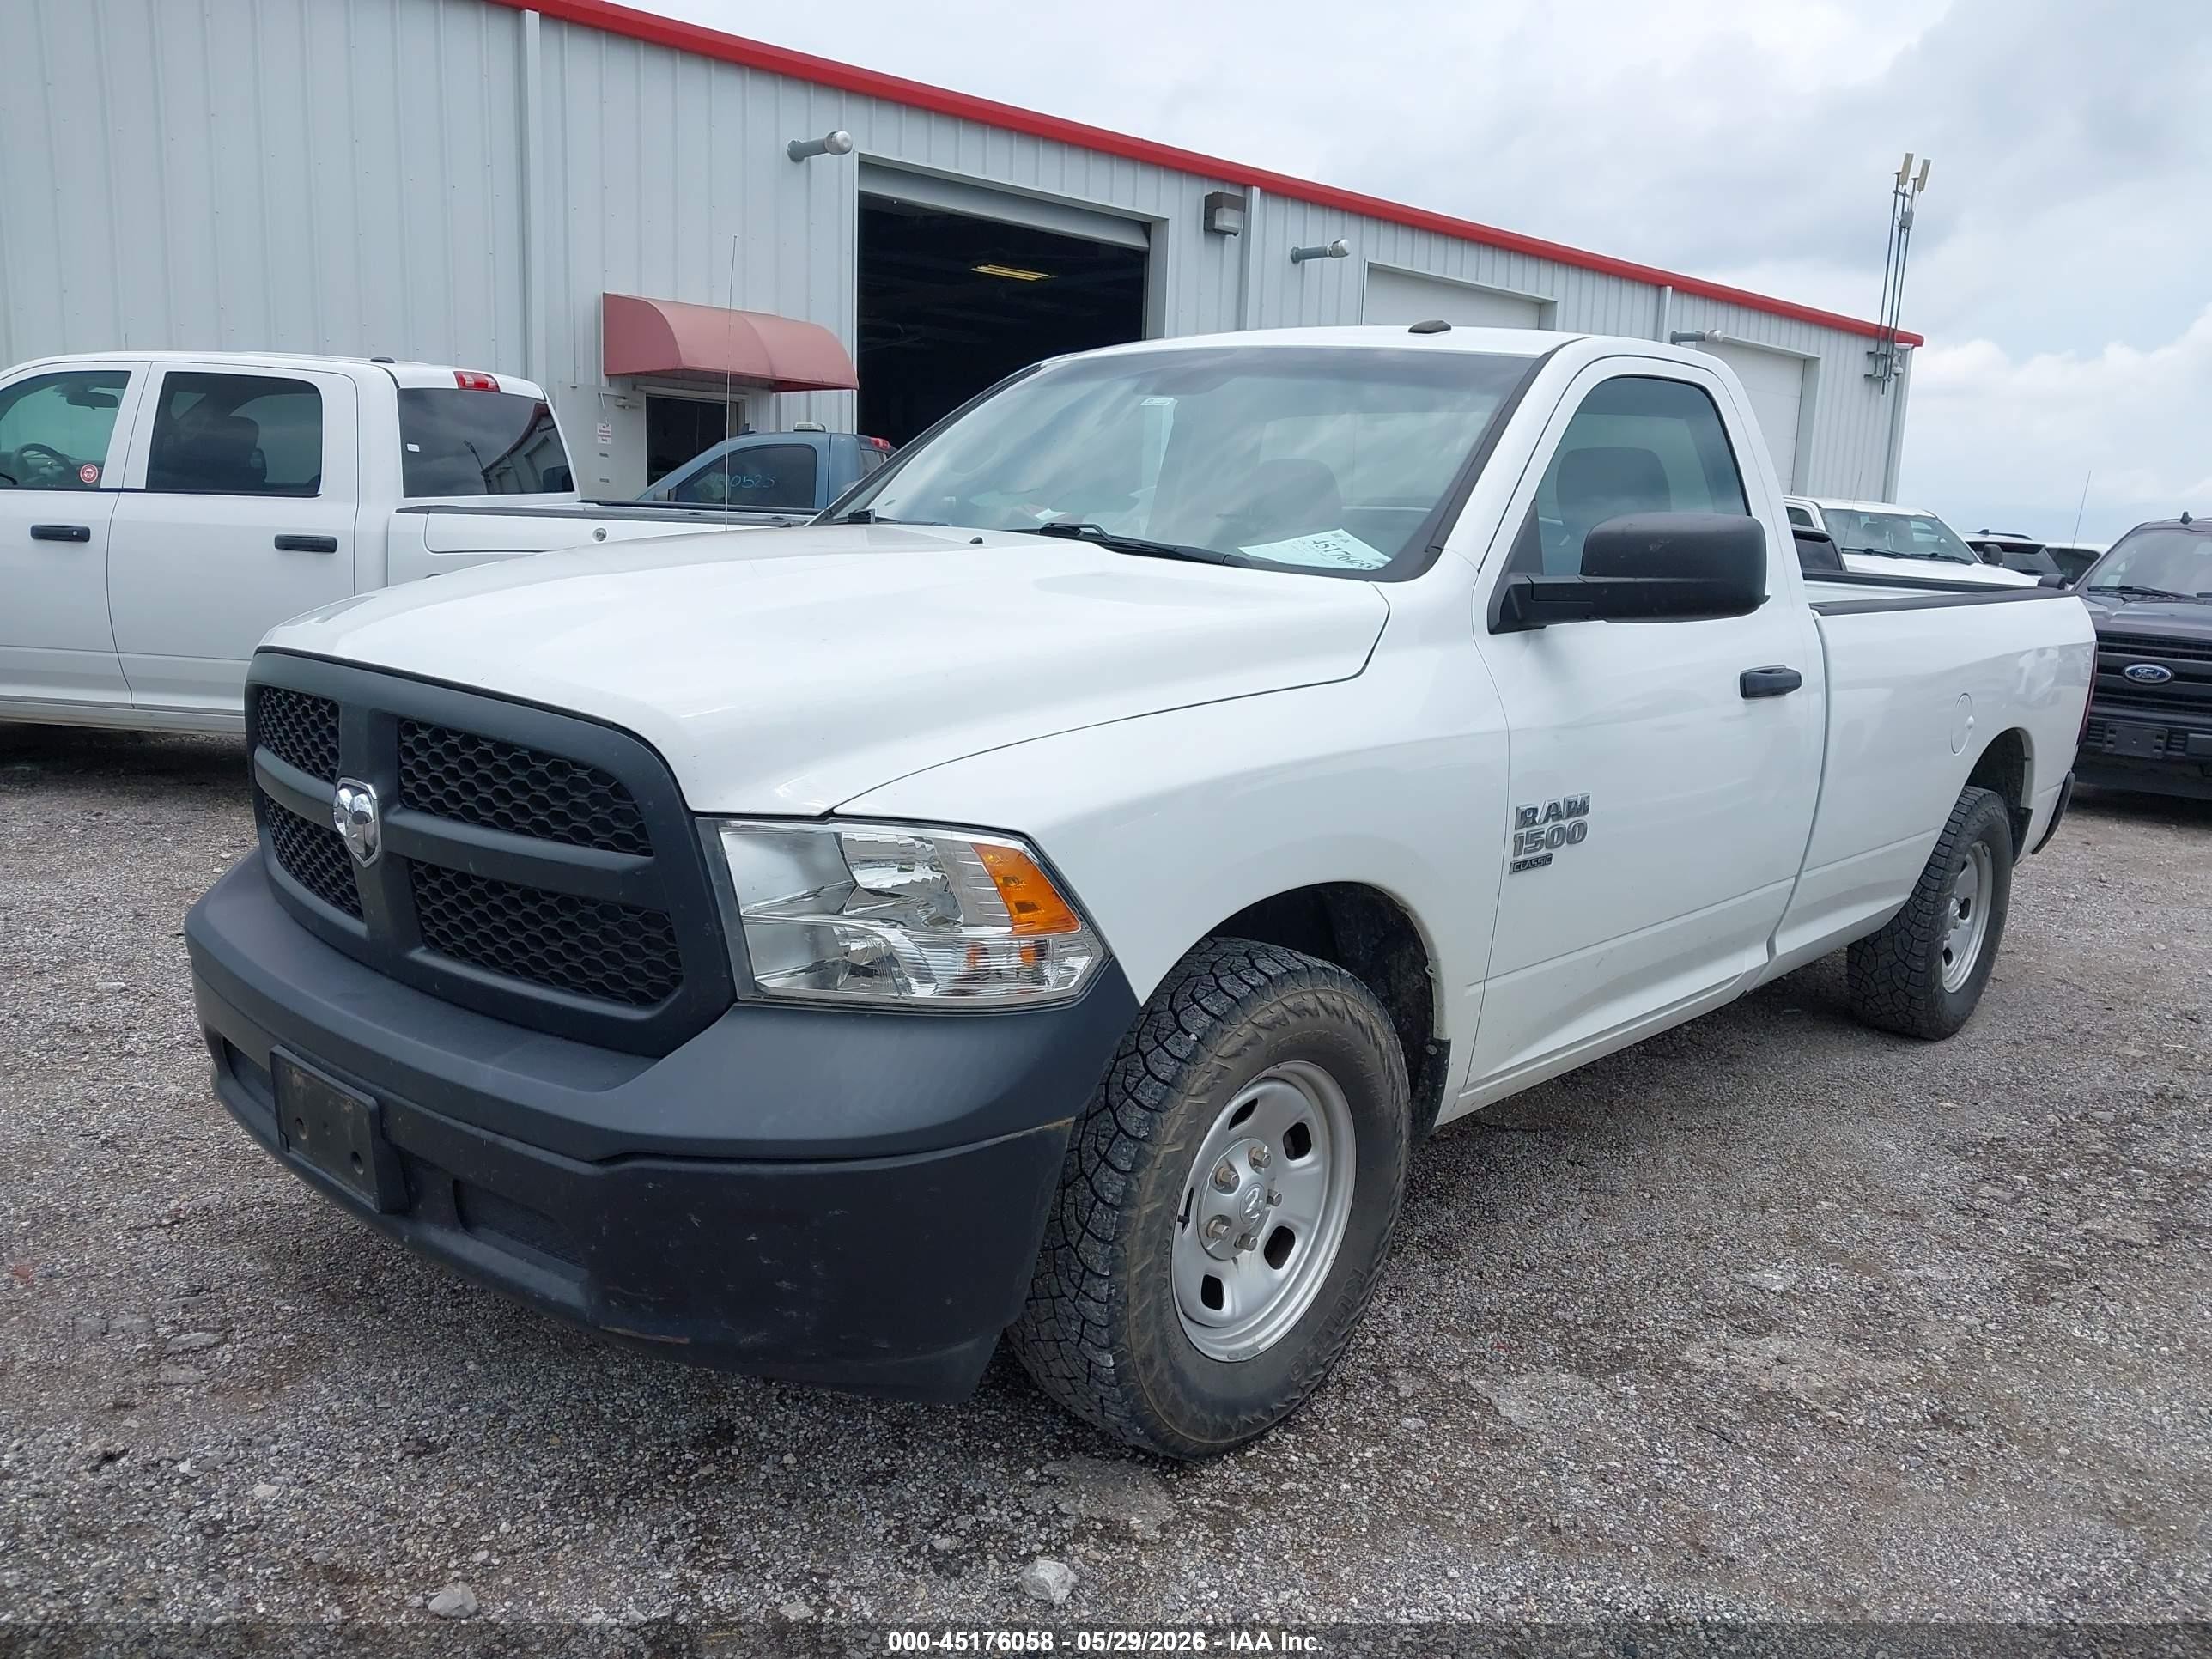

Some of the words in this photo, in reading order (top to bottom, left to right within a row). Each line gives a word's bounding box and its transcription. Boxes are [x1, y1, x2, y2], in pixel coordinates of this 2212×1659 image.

[1515, 793, 1591, 830] RAM
[1513, 819, 1588, 858] 1500
[1512, 854, 1553, 872] CLASSIC
